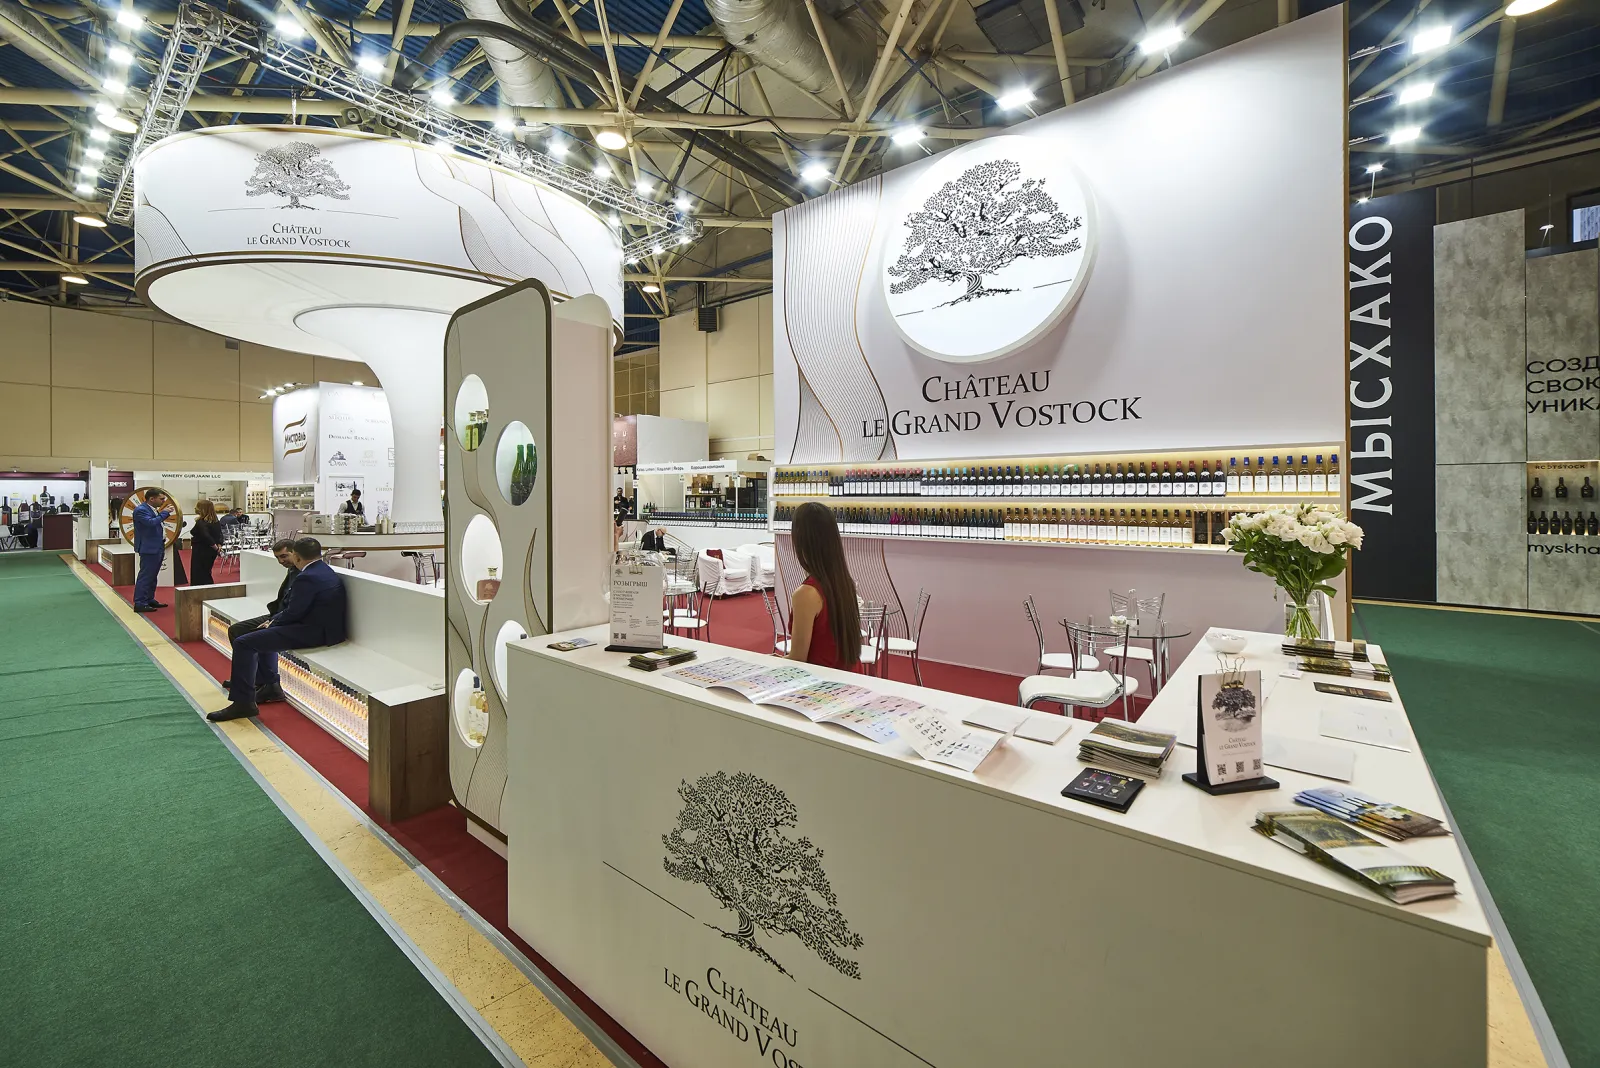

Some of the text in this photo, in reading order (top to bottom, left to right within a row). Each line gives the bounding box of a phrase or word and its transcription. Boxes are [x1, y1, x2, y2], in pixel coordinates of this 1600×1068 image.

[247, 234, 351, 248] LE GRAND VOSTOCK
[272, 222, 322, 235] CHÂTEAU
[1349, 215, 1392, 515] МЫСХАКО
[1526, 355, 1600, 374] СОЗД
[921, 369, 1052, 403] CHÂTEAU
[861, 396, 1143, 438] LE GRAND VOSTOCK
[1526, 397, 1600, 414] УНИК
[663, 967, 681, 994] LE
[685, 979, 749, 1042] GRAND
[706, 967, 798, 1047] CHÂTEAU
